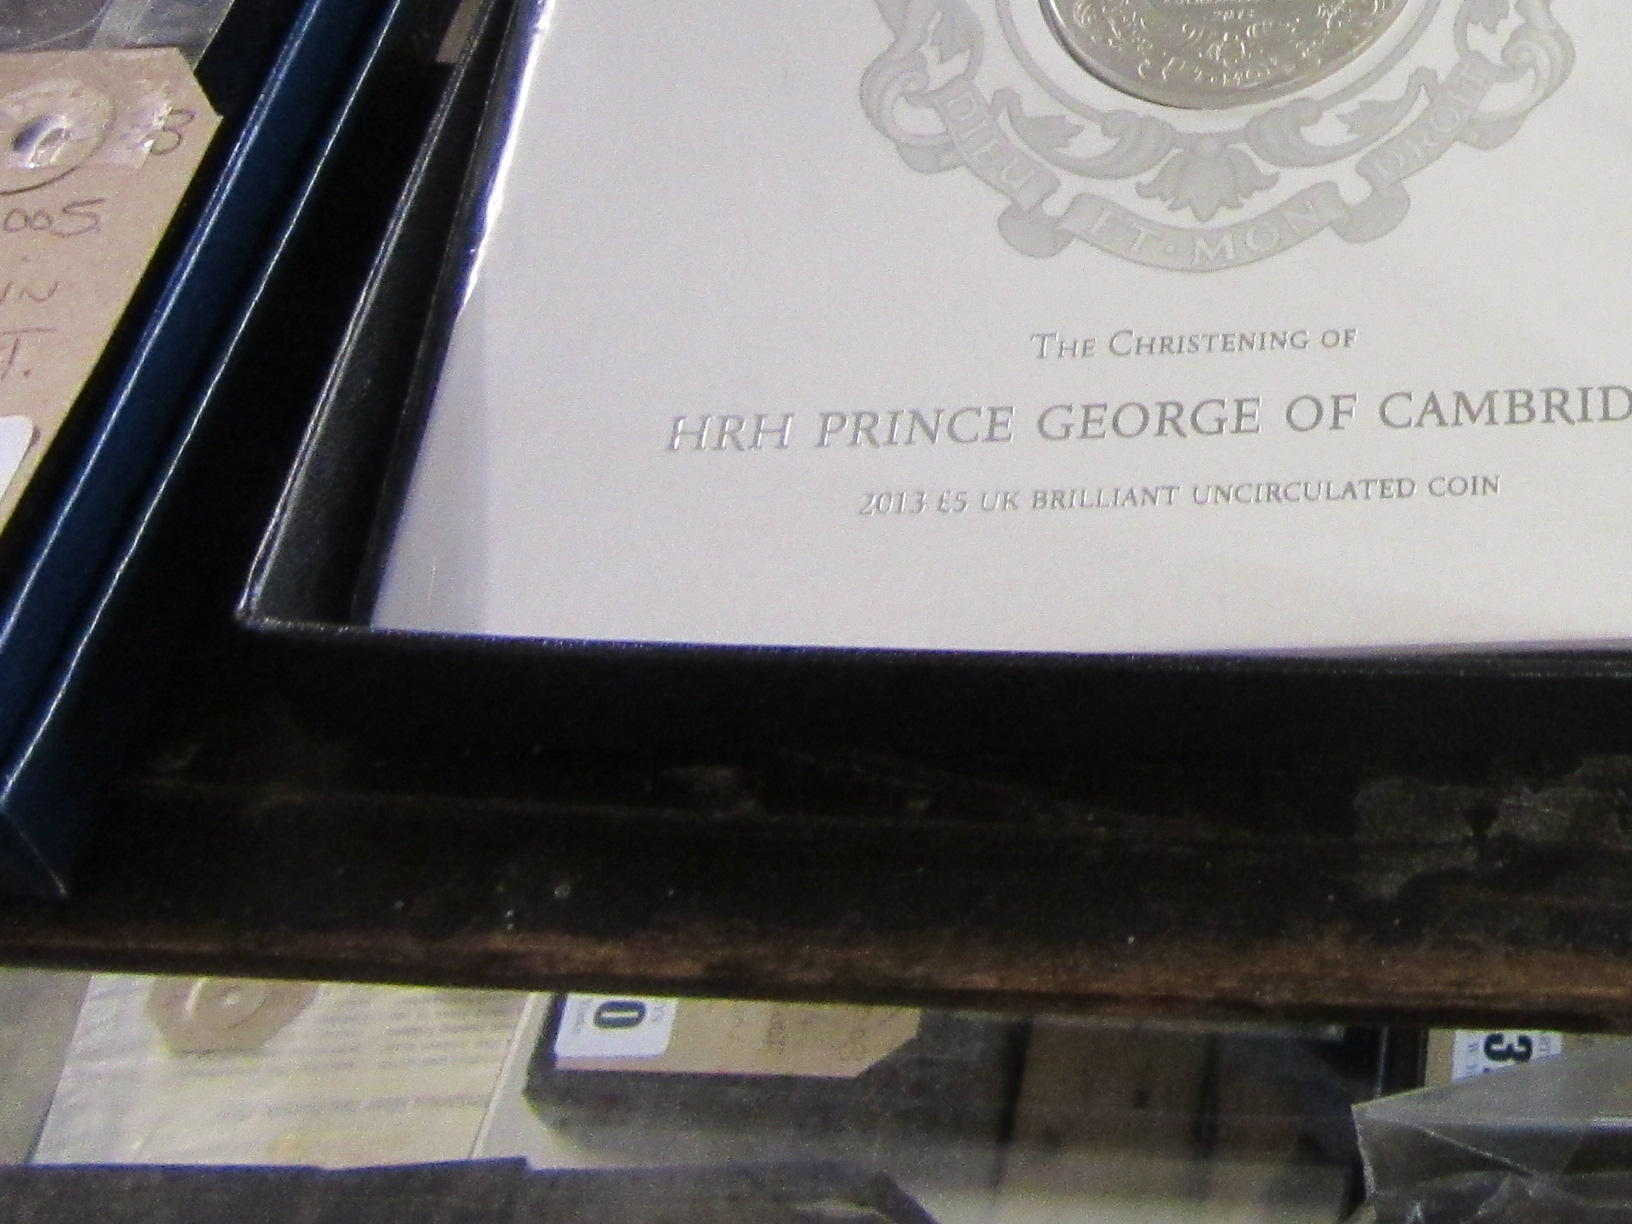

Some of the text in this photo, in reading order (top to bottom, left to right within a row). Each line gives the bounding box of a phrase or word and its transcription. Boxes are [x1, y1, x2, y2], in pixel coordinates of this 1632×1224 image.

[1030, 327, 1359, 361] THE CHRISTENING OF
[665, 411, 795, 453] HRH
[813, 405, 1017, 449] PRINCE
[1037, 395, 1264, 443] GEORGE
[1284, 392, 1359, 433] OF
[858, 474, 1502, 516] 2013 £5 UK BRILLIANT UNCIRCULATED COIN
